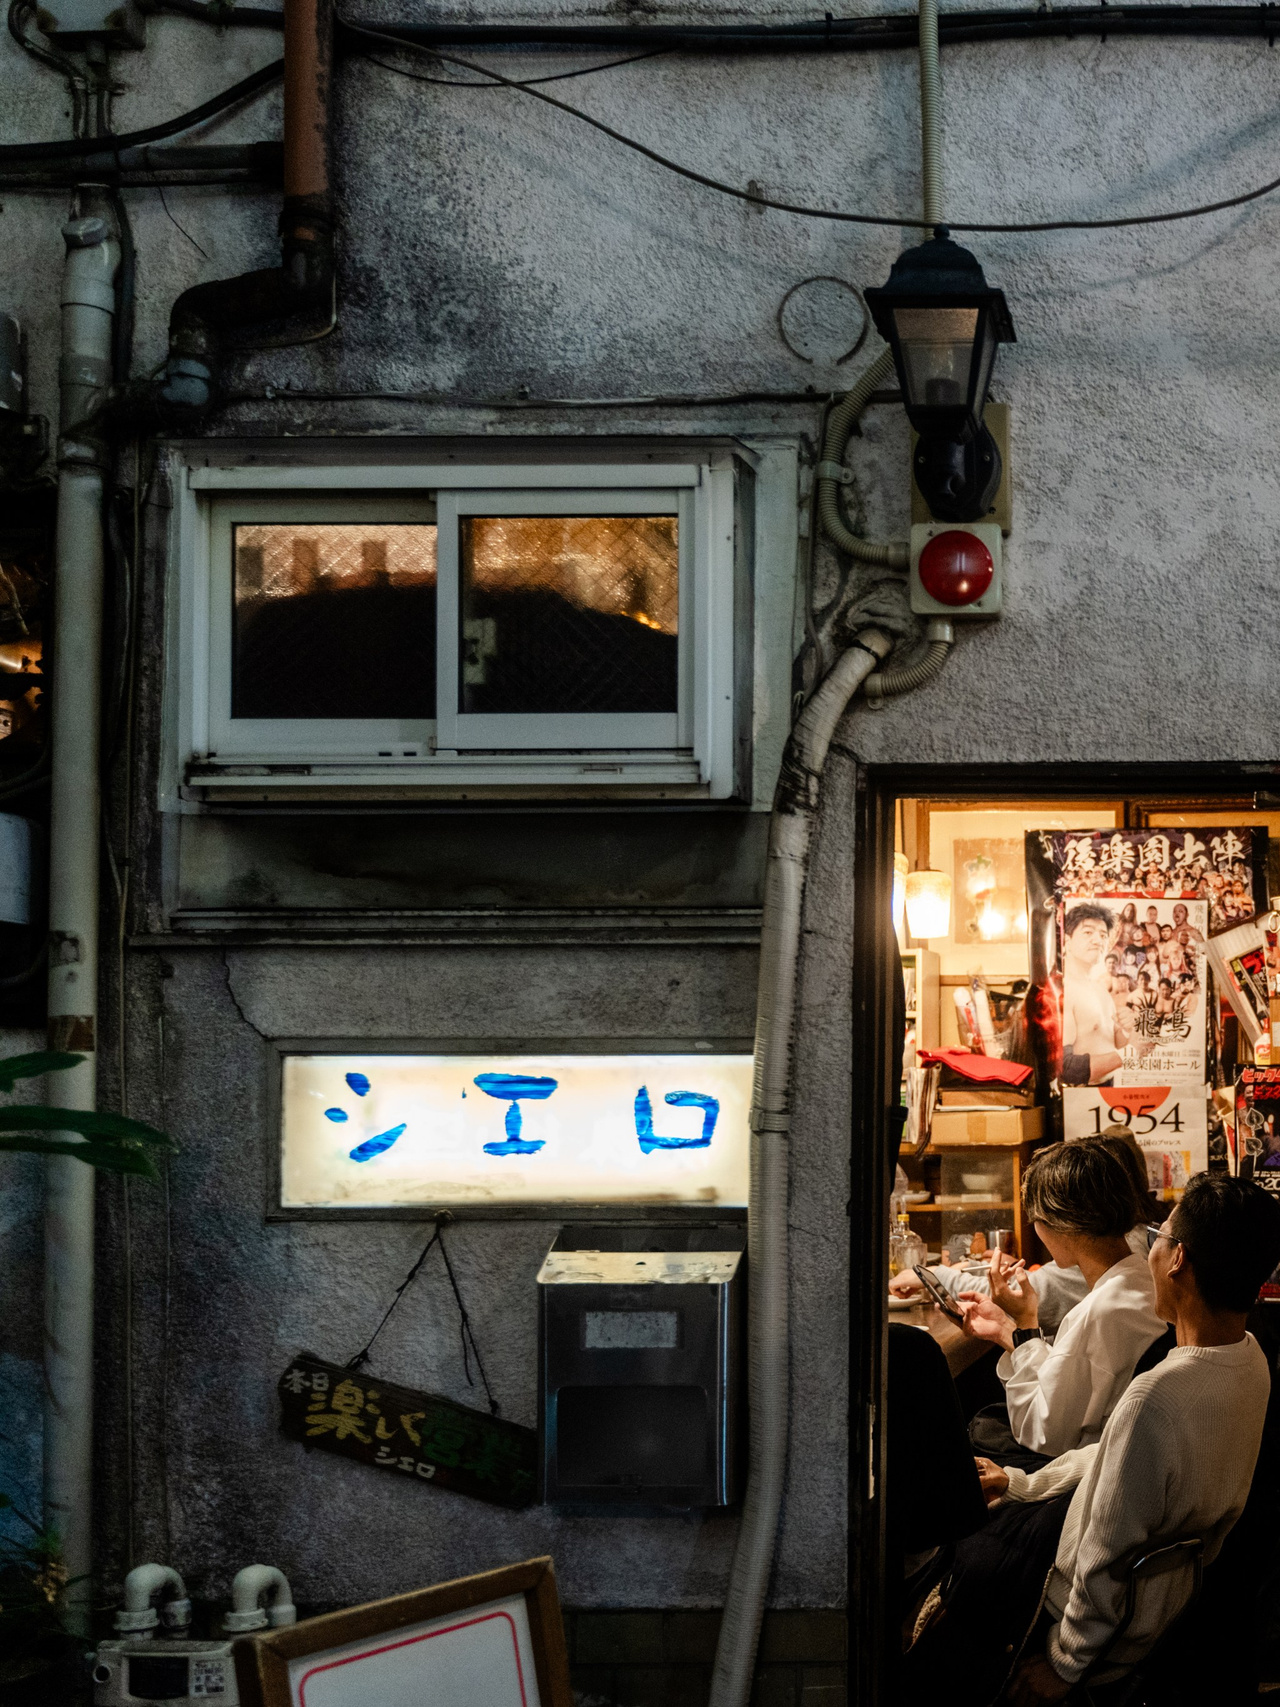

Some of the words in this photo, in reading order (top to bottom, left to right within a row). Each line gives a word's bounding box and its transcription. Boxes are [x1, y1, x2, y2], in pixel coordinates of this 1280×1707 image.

[1122, 1058, 1202, 1071] 後楽園ホール
[1088, 1102, 1185, 1135] 1954
[284, 1368, 330, 1394] 本日
